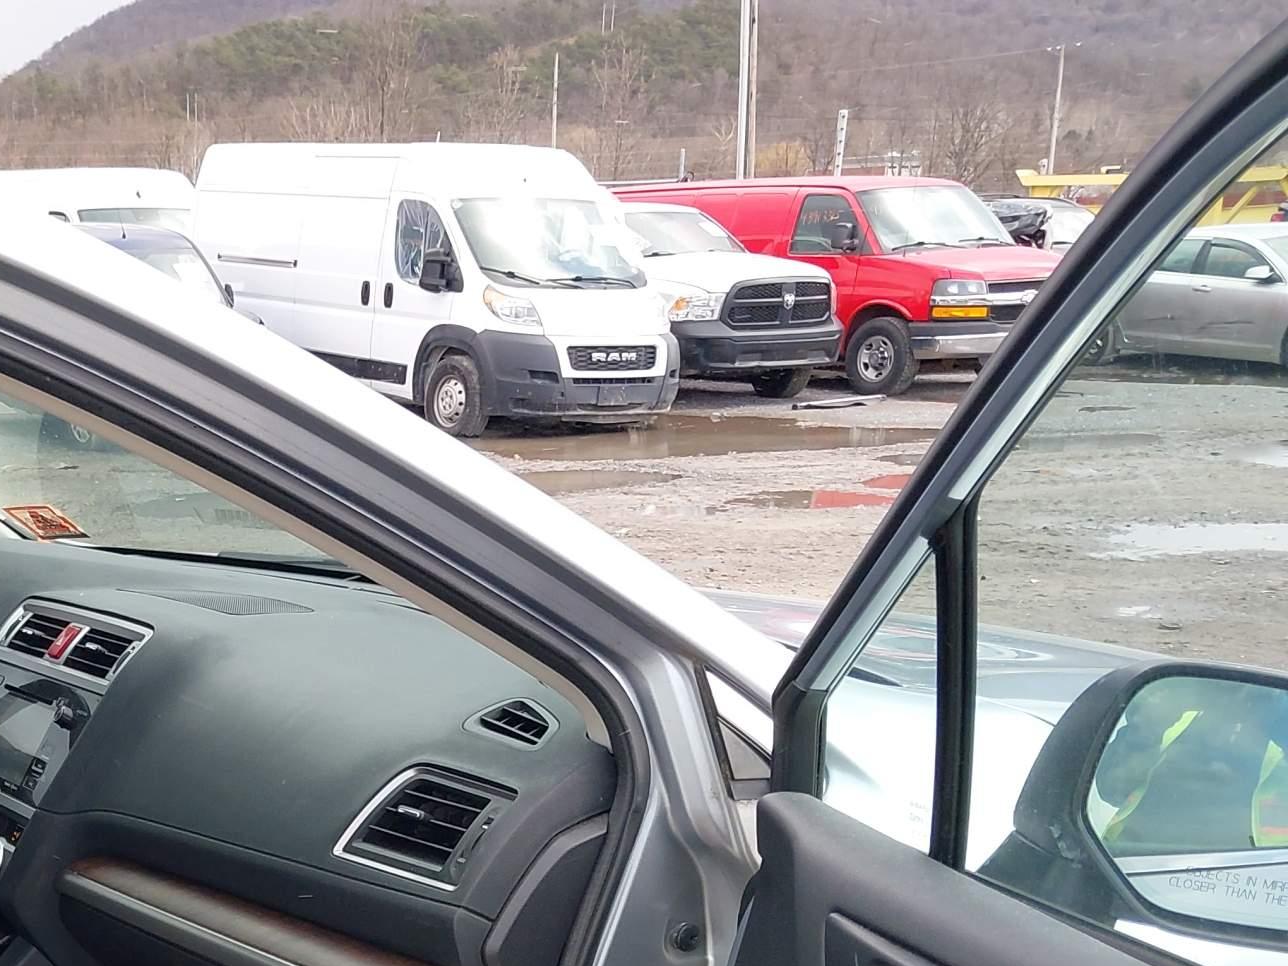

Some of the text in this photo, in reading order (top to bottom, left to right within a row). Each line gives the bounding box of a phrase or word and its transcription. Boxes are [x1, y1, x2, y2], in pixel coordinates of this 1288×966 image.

[591, 352, 636, 362] RAM
[1169, 876, 1217, 894] CLOSER
[1225, 885, 1257, 902] THAN
